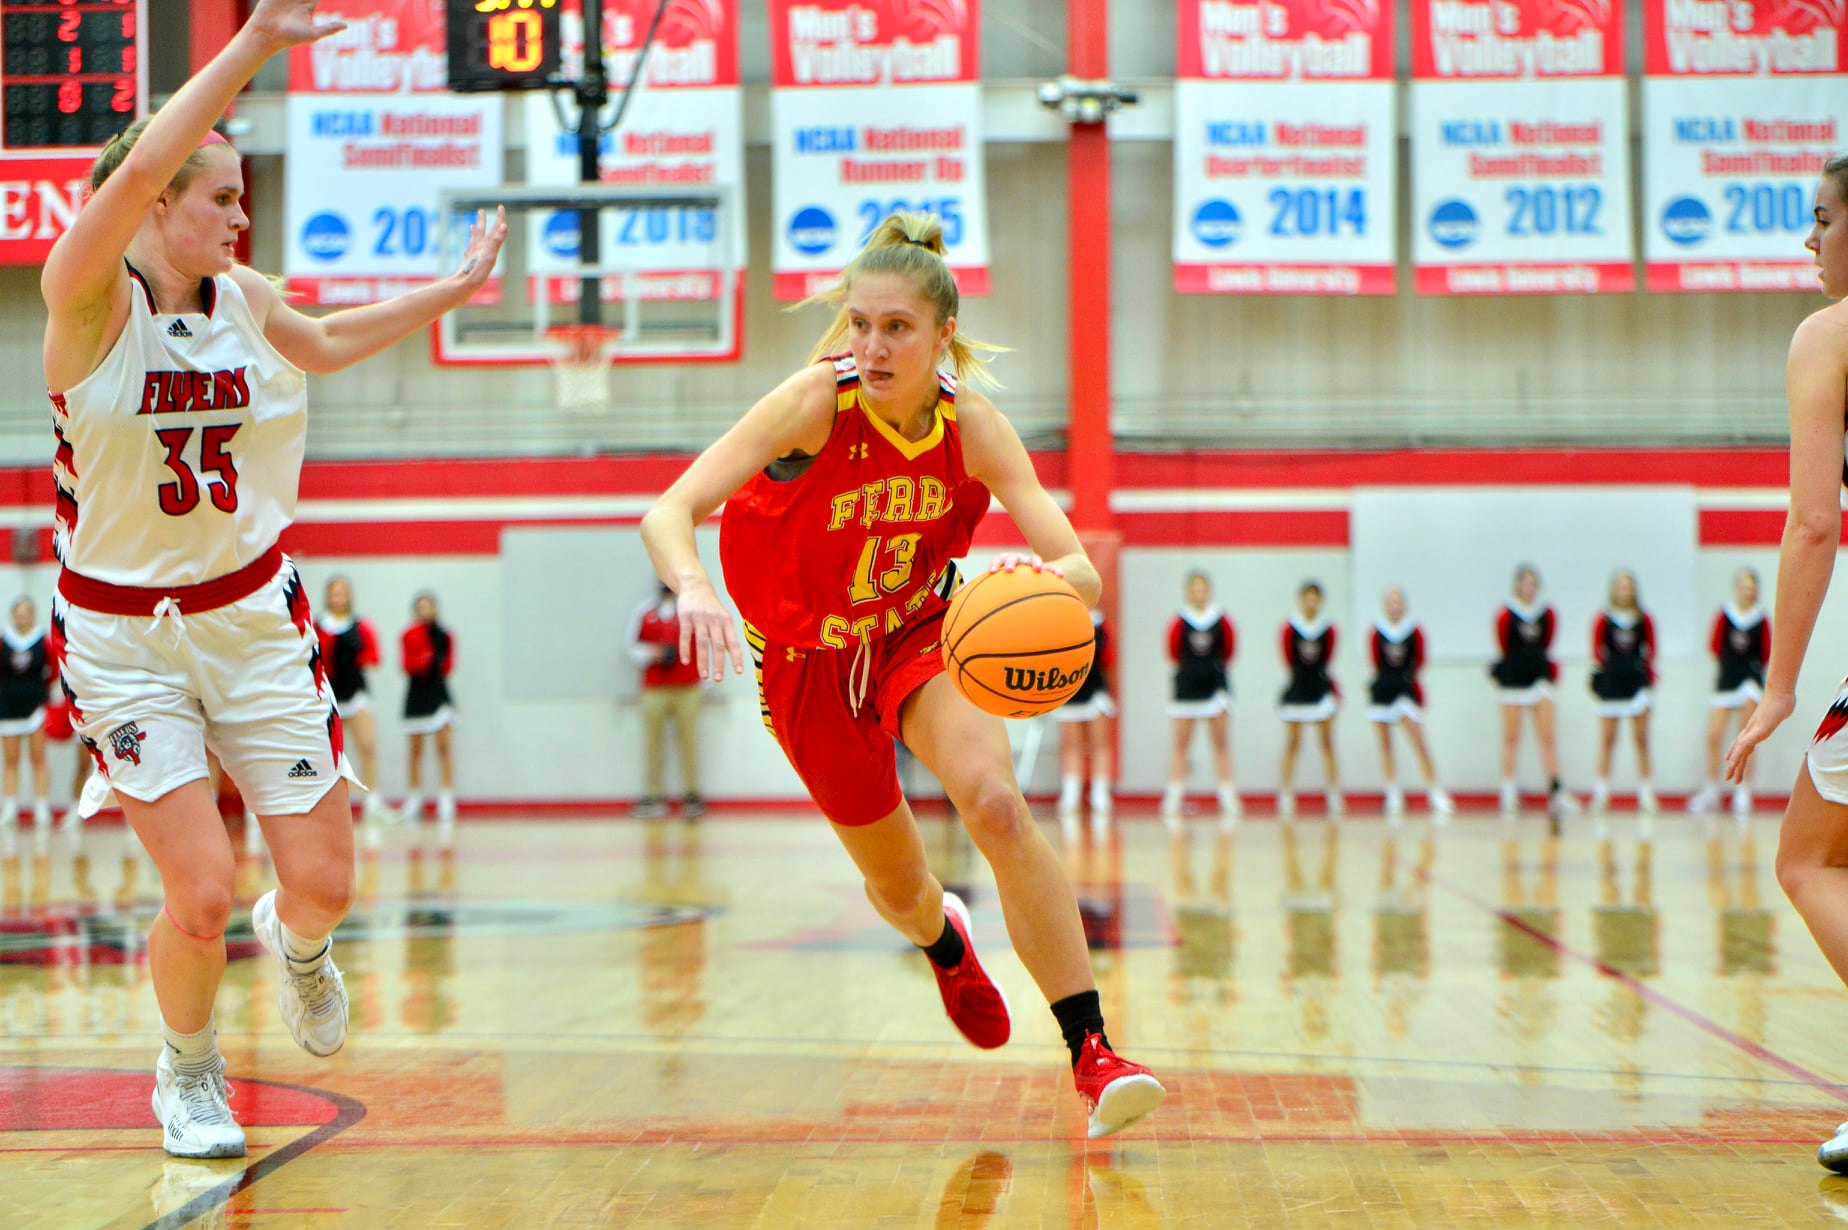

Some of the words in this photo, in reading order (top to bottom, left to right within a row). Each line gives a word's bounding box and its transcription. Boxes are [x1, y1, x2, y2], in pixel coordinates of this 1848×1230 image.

[789, 6, 877, 42] Men's
[1201, 0, 1287, 37] Men's
[489, 9, 543, 72] 10
[1201, 32, 1370, 82] Volleyball
[1431, 29, 1604, 80] Volleyball
[1666, 27, 1837, 77] Volleyball
[310, 45, 448, 94] Volleyba
[789, 36, 960, 84] Volleyball
[312, 111, 373, 136] NCAA
[381, 114, 481, 136] National
[795, 128, 856, 151] NCAA
[864, 127, 964, 150] National
[1206, 123, 1266, 146] NCAA
[1275, 122, 1365, 147] National
[1441, 121, 1501, 144] NCAA
[1510, 121, 1602, 145] National
[1674, 118, 1735, 142] NCAA
[1743, 117, 1835, 142] National
[624, 131, 713, 154] National
[841, 160, 927, 182] Runner
[1469, 154, 1602, 178] Semifinalist
[1702, 150, 1824, 175] Semifinalis
[1268, 187, 1366, 236] 2014
[1506, 185, 1604, 236] 2012
[136, 365, 250, 415] FLYERS
[154, 423, 243, 516] 35
[828, 475, 953, 531] FERR
[848, 532, 922, 607] 13
[1004, 661, 1089, 691] Wilson
[288, 770, 318, 778] adidas
